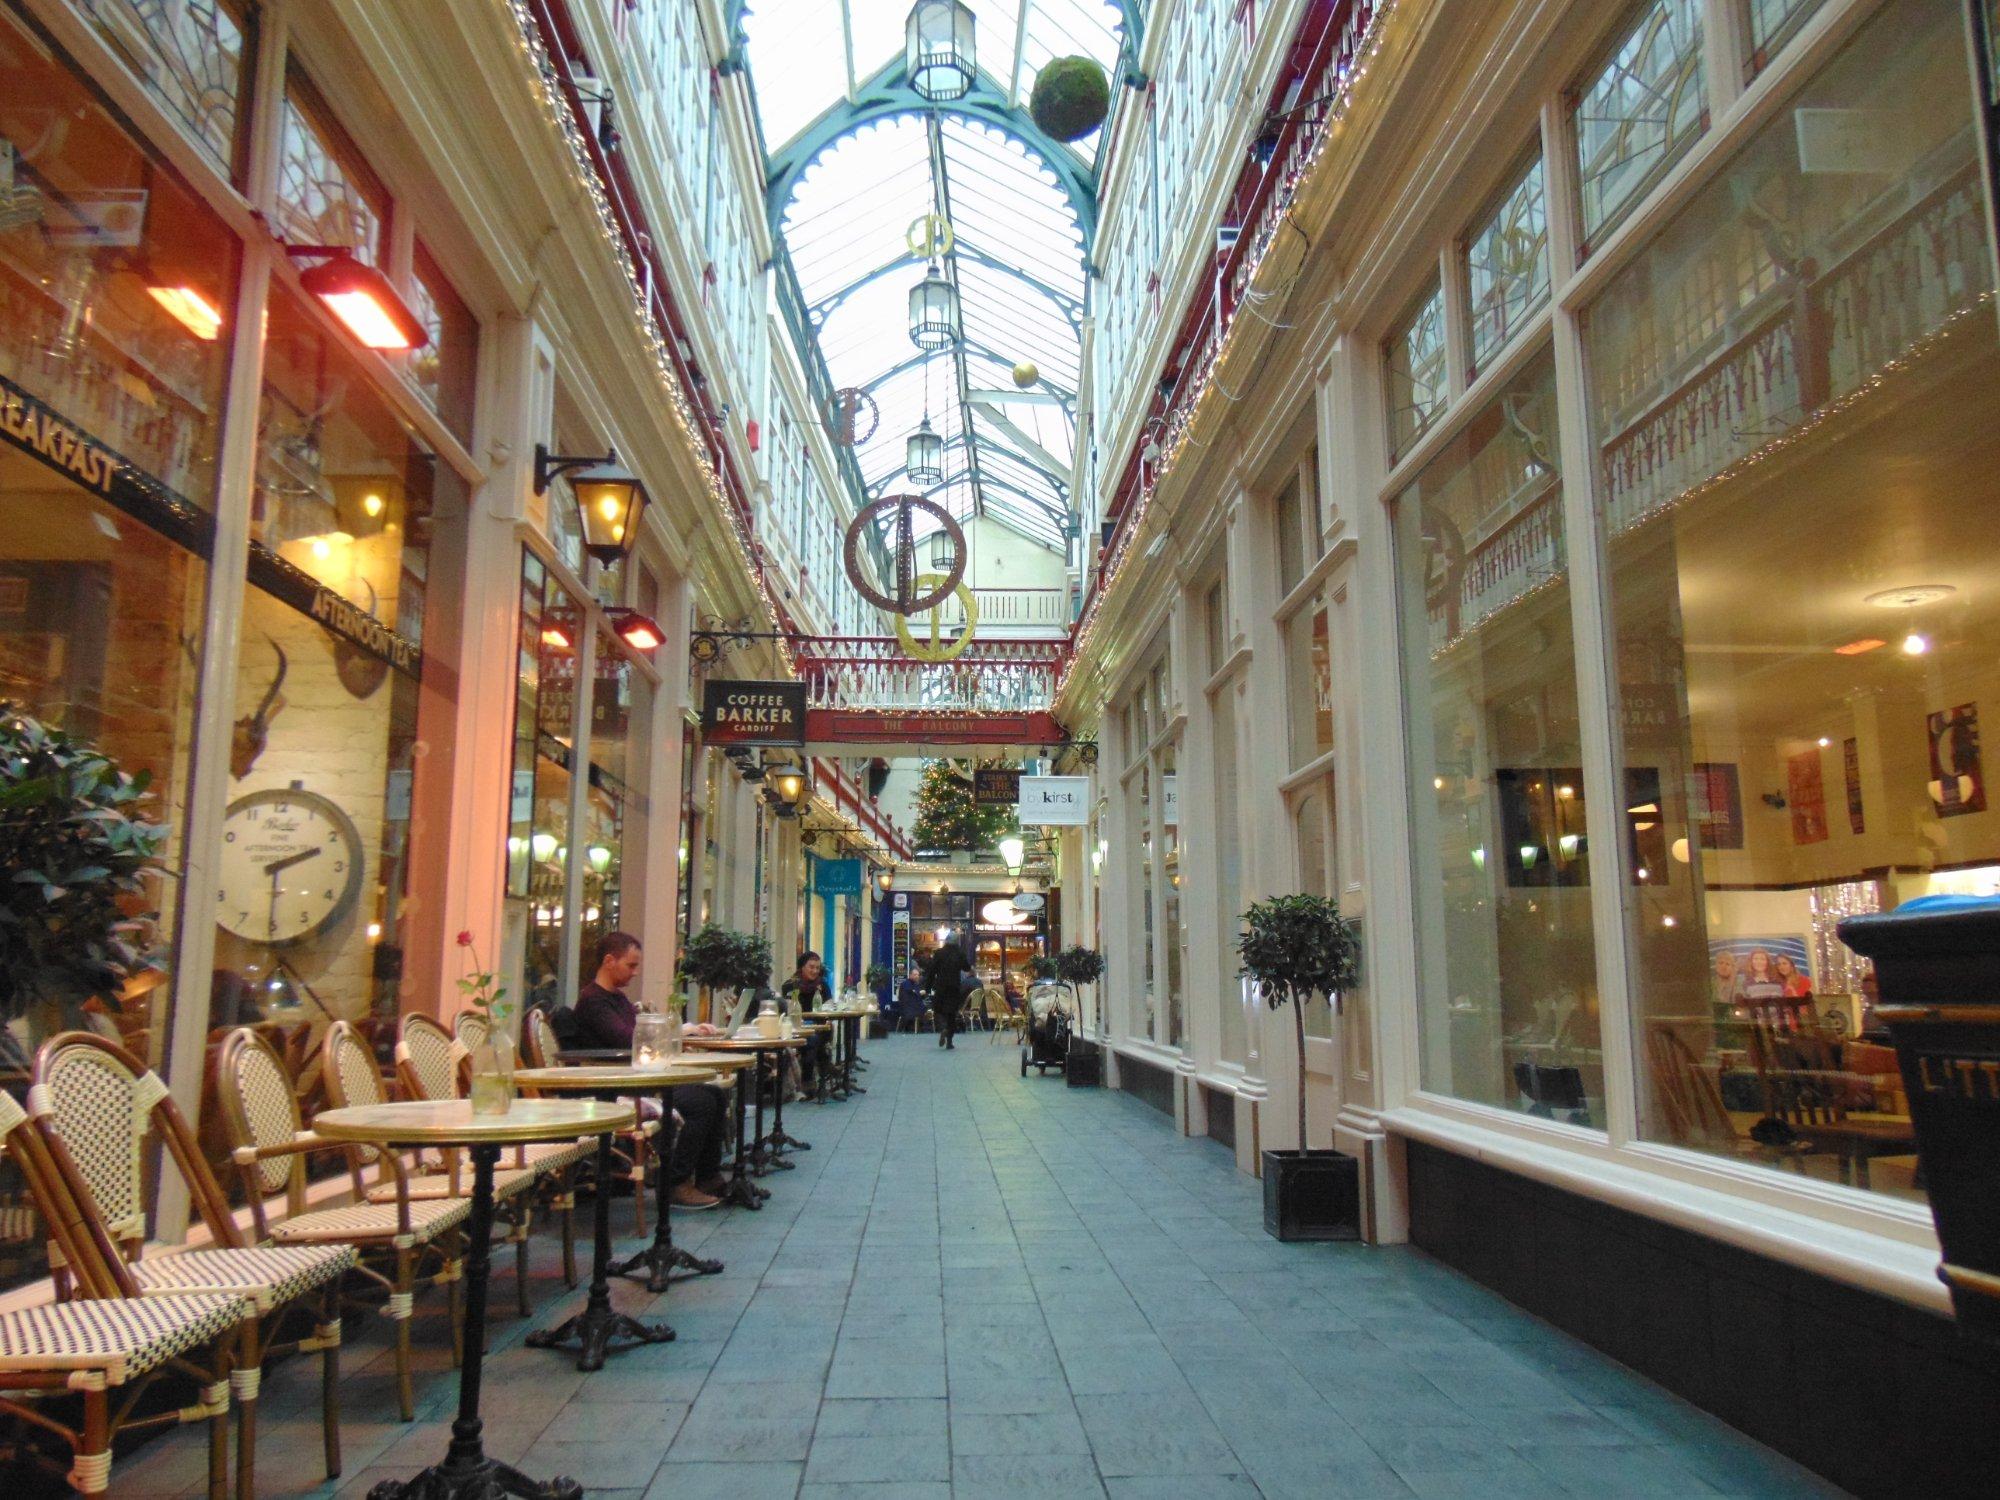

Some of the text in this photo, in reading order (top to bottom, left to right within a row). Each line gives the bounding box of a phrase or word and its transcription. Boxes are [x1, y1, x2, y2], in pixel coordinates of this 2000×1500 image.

[311, 588, 410, 669] AFTERNOON TEA
[727, 694, 783, 706] COFFEE
[716, 707, 792, 723] BARKER
[733, 724, 776, 733] CARDIFF
[883, 719, 976, 732] THE BALCONY
[990, 781, 1010, 790] THE
[978, 790, 1018, 799] BALCON
[273, 801, 288, 813] 12
[245, 809, 259, 821] 11
[328, 831, 338, 843] 2
[334, 860, 344, 873] 3
[323, 888, 334, 901] 4
[239, 912, 249, 924] 7
[300, 911, 309, 924] 5
